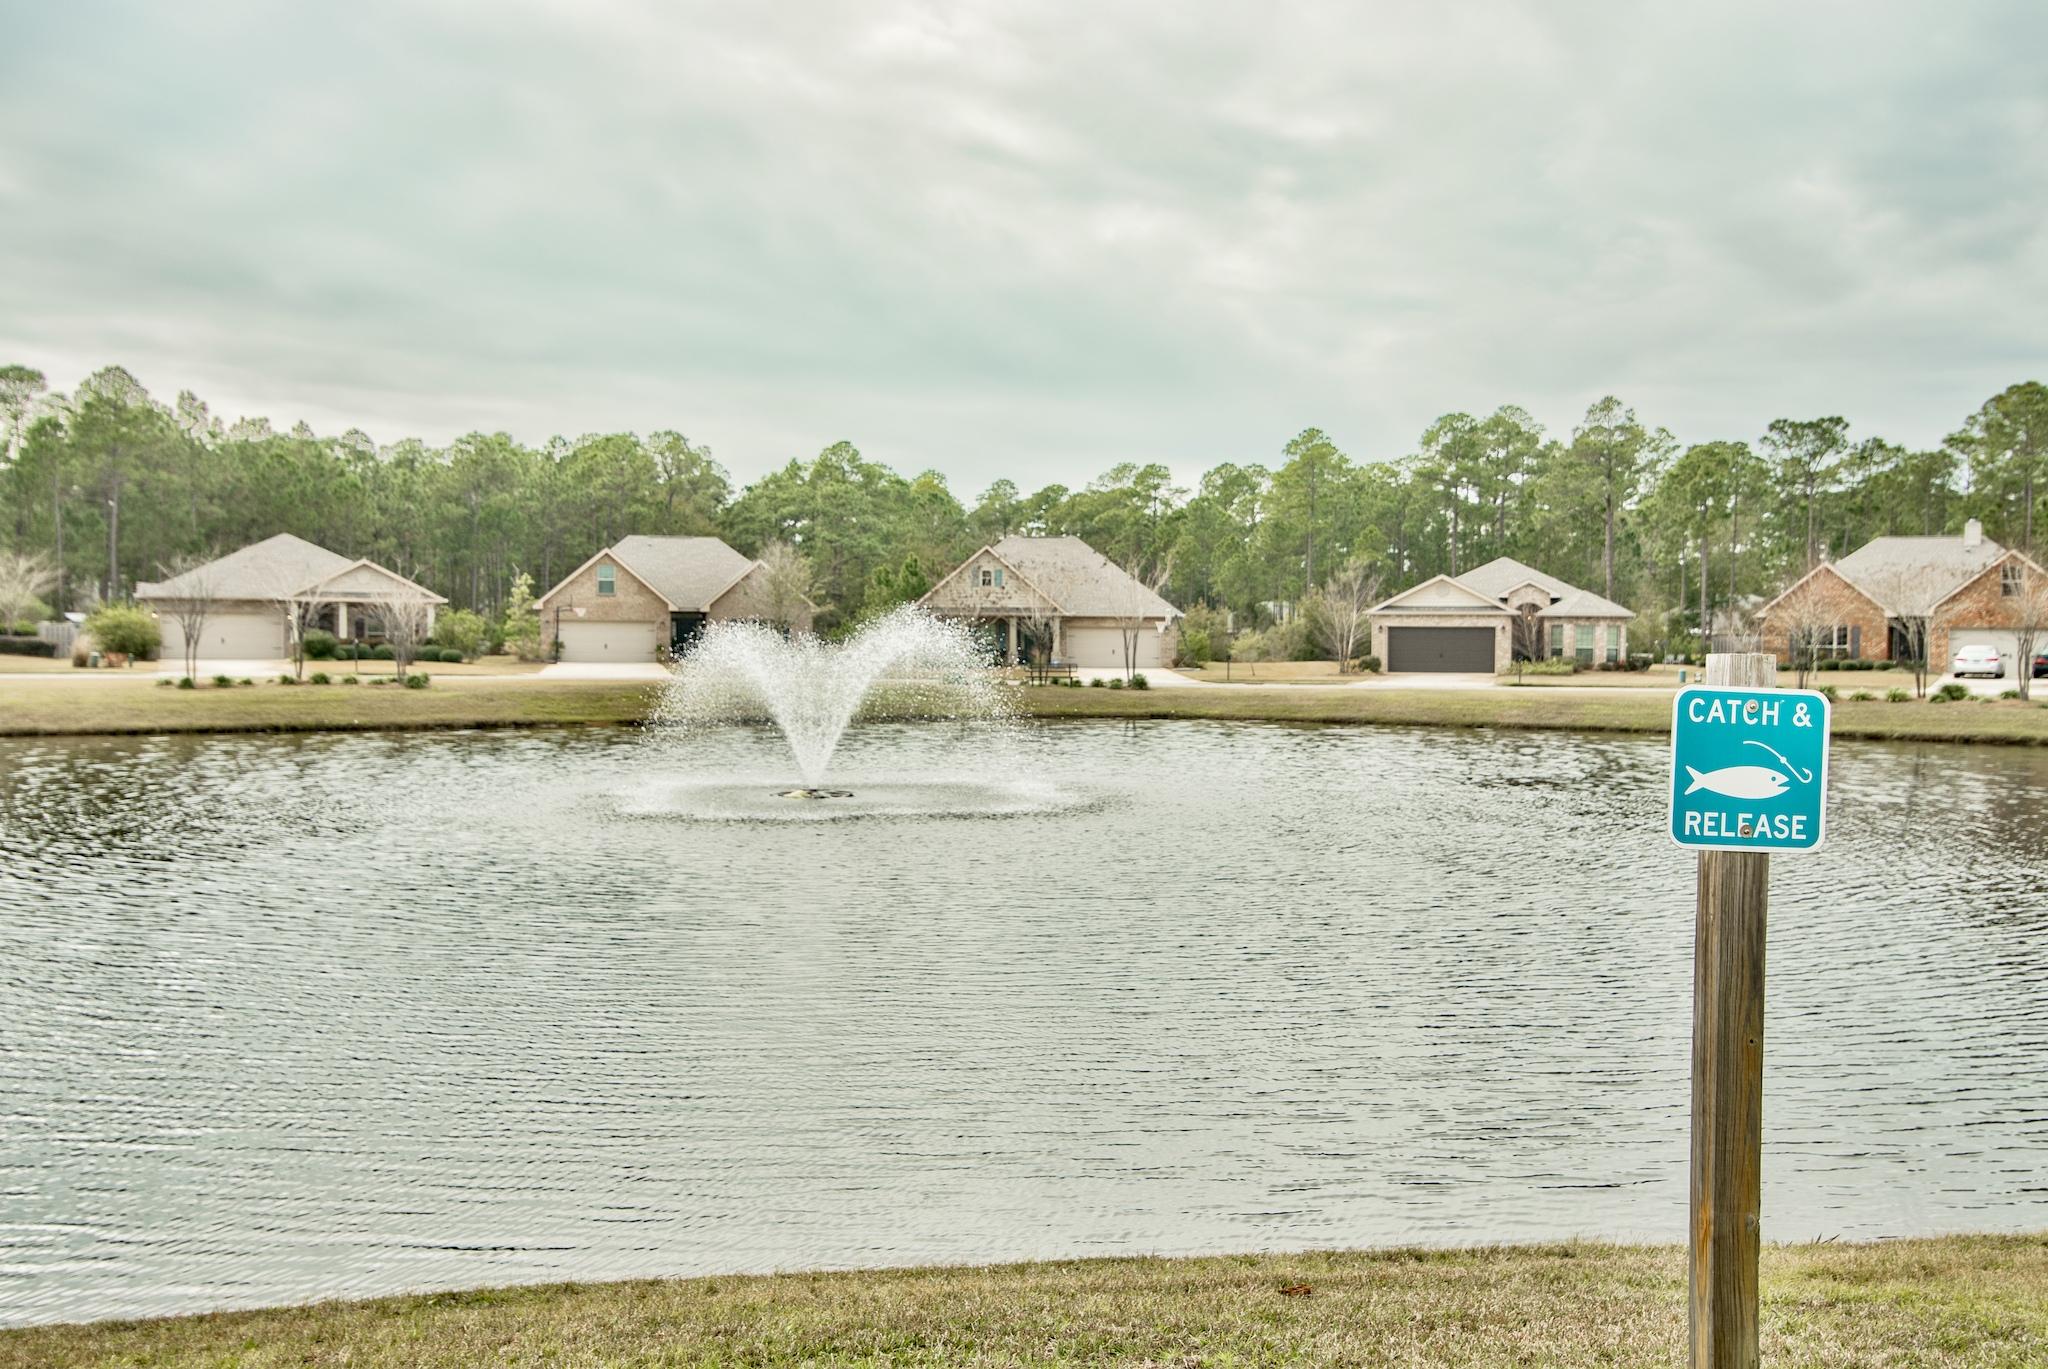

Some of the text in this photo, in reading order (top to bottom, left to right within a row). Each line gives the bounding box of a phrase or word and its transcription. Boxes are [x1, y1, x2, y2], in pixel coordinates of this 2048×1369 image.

[1688, 697, 1812, 728] CATCH &
[1684, 810, 1807, 840] RELEASE
